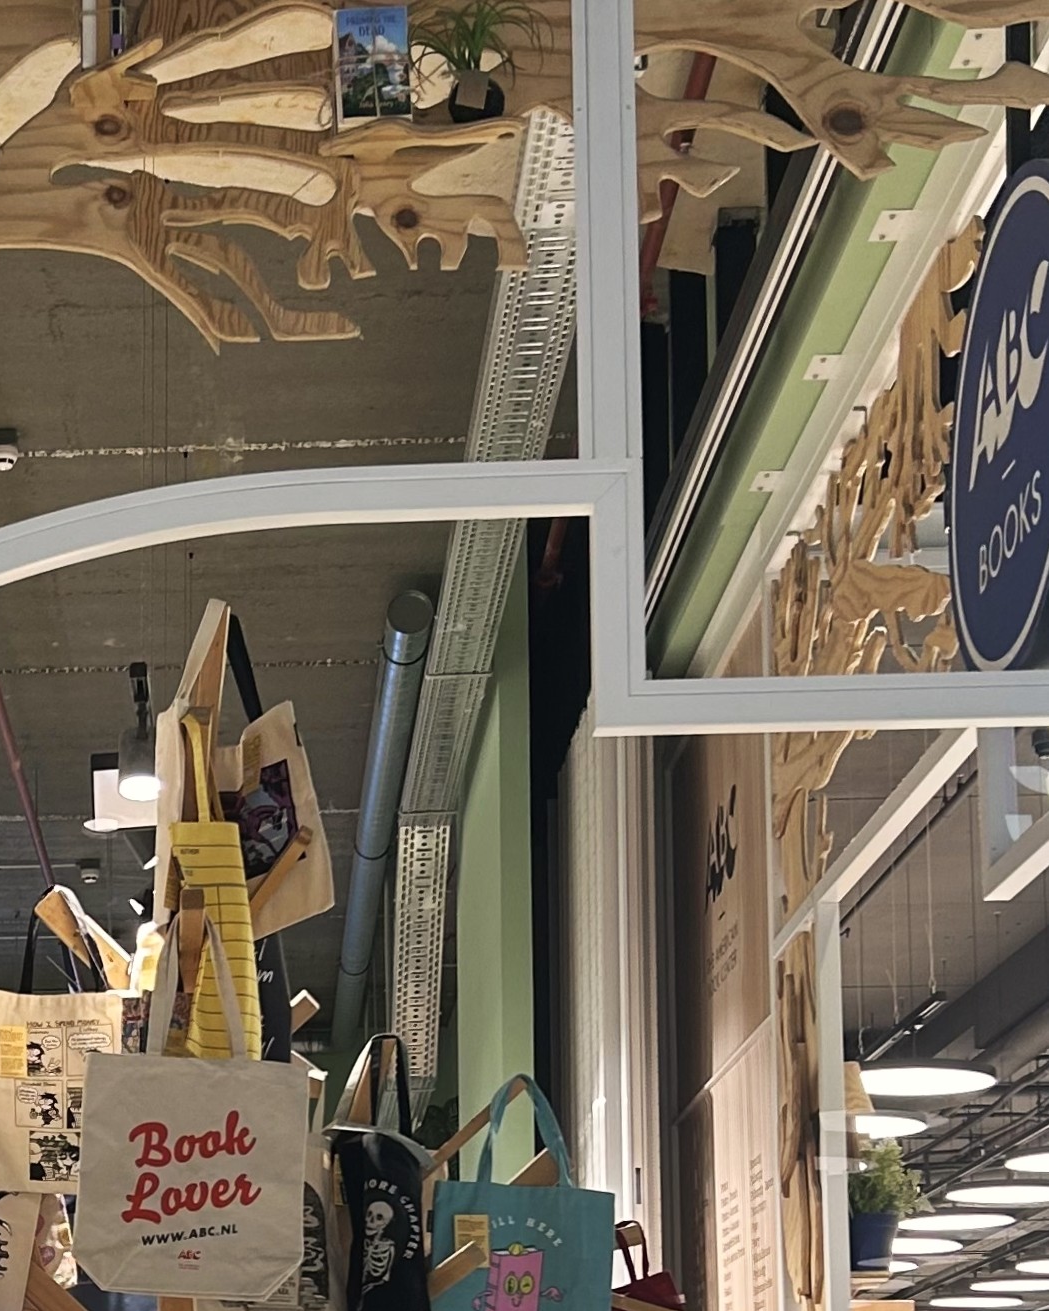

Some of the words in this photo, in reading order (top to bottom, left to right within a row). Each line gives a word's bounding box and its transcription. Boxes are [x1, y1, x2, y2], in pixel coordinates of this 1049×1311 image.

[978, 470, 1042, 596] BOOKS
[705, 784, 738, 915] ABC
[128, 1110, 257, 1168] Book
[120, 1172, 262, 1225] Lover
[141, 1223, 239, 1246] WWW.ABC.NL
[526, 1217, 563, 1247] HERE
